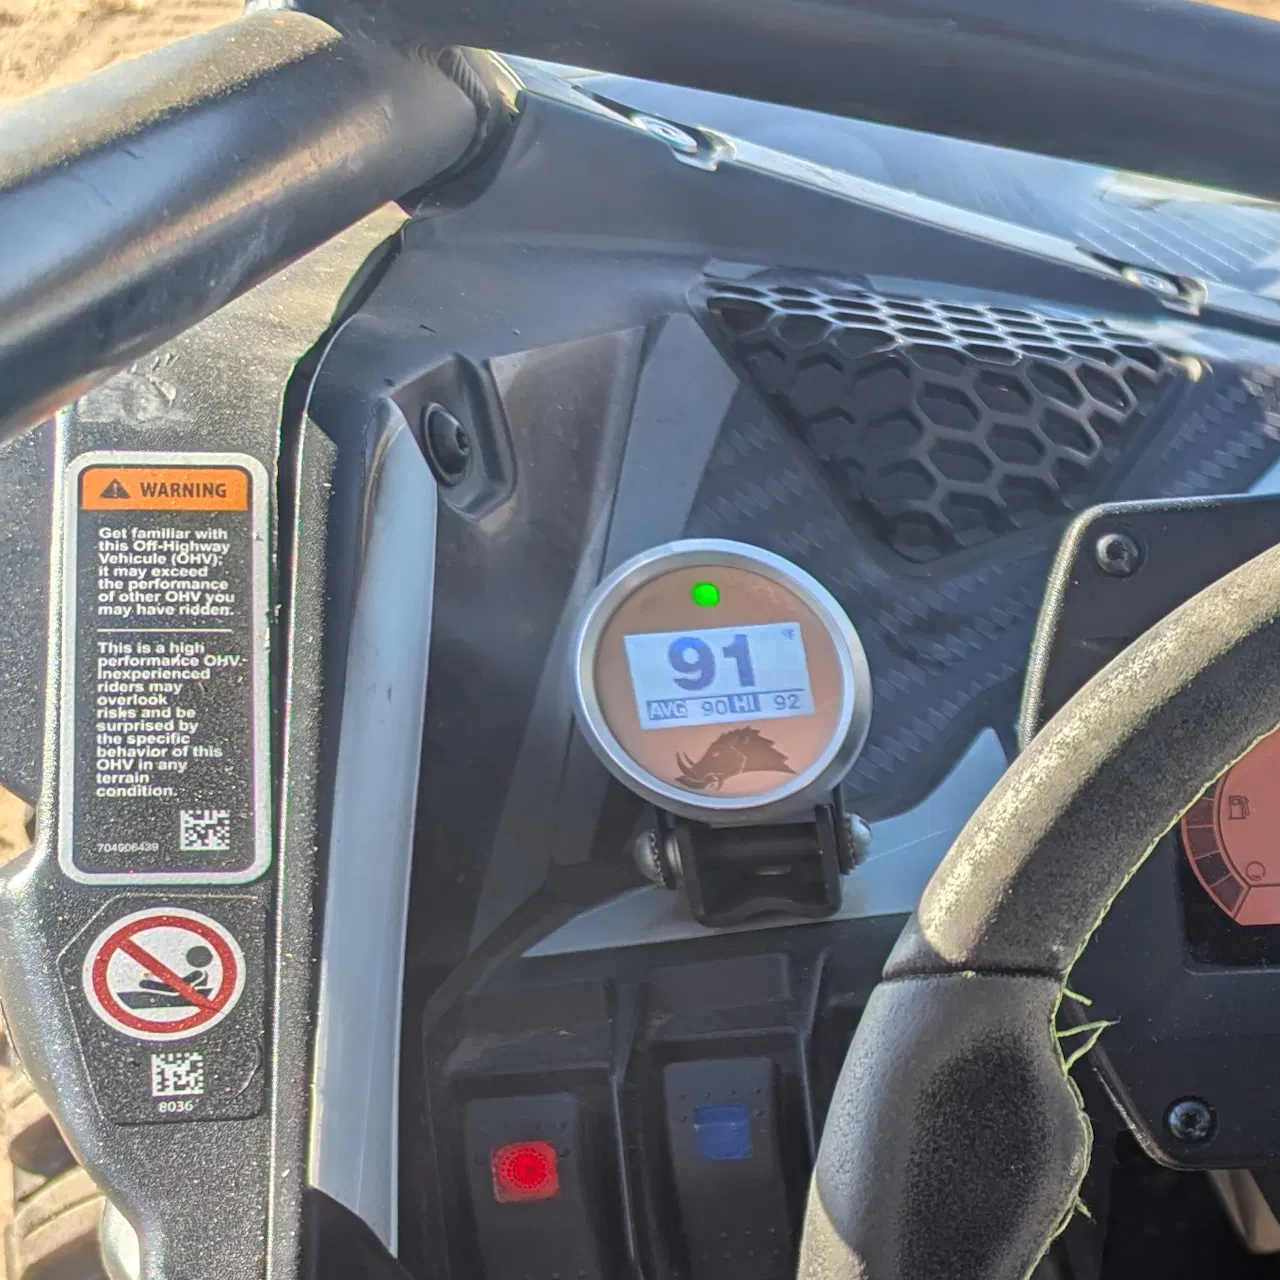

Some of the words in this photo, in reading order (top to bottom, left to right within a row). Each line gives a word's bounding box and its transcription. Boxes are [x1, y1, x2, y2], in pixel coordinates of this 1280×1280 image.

[140, 482, 227, 499] WARNING
[98, 527, 127, 539] Get
[132, 527, 191, 540] familiar
[195, 527, 228, 540] with
[98, 540, 129, 552] this
[133, 540, 231, 554] Off-Highway
[98, 552, 167, 565] Vehicule
[98, 566, 109, 577] it
[113, 567, 147, 579] may
[151, 566, 209, 577] exceed
[98, 578, 124, 590] the
[128, 578, 229, 591] performance
[98, 591, 115, 602] of
[118, 591, 161, 602] other
[165, 591, 202, 602] OHV
[205, 593, 235, 604] you
[98, 605, 132, 618] may
[136, 603, 175, 616] have
[179, 603, 235, 616] ridden.
[97, 642, 132, 654] This
[137, 641, 151, 654] is
[155, 644, 165, 654] a
[169, 641, 205, 656] high
[98, 655, 200, 668] performance
[667, 633, 757, 692] 91
[98, 666, 211, 681] Inexperienced
[97, 681, 144, 693] riders
[149, 683, 183, 695] may
[97, 694, 168, 706] overlook
[649, 700, 688, 720] AVG
[701, 699, 728, 717] 90
[733, 694, 760, 713] HI
[773, 693, 801, 711] 92
[96, 707, 137, 719] risks
[141, 707, 172, 719] and
[175, 706, 196, 719] be
[95, 720, 174, 733] surprised
[178, 720, 199, 734] by
[96, 733, 122, 744] the
[126, 733, 190, 746] specific
[96, 745, 168, 757] behavior
[171, 745, 189, 757] of
[192, 745, 223, 757] this
[96, 759, 134, 771] OHV
[138, 758, 153, 770] in
[158, 760, 188, 773] any
[96, 772, 150, 784] terrain
[95, 785, 177, 797] condition.
[158, 1100, 194, 1113] 8036
